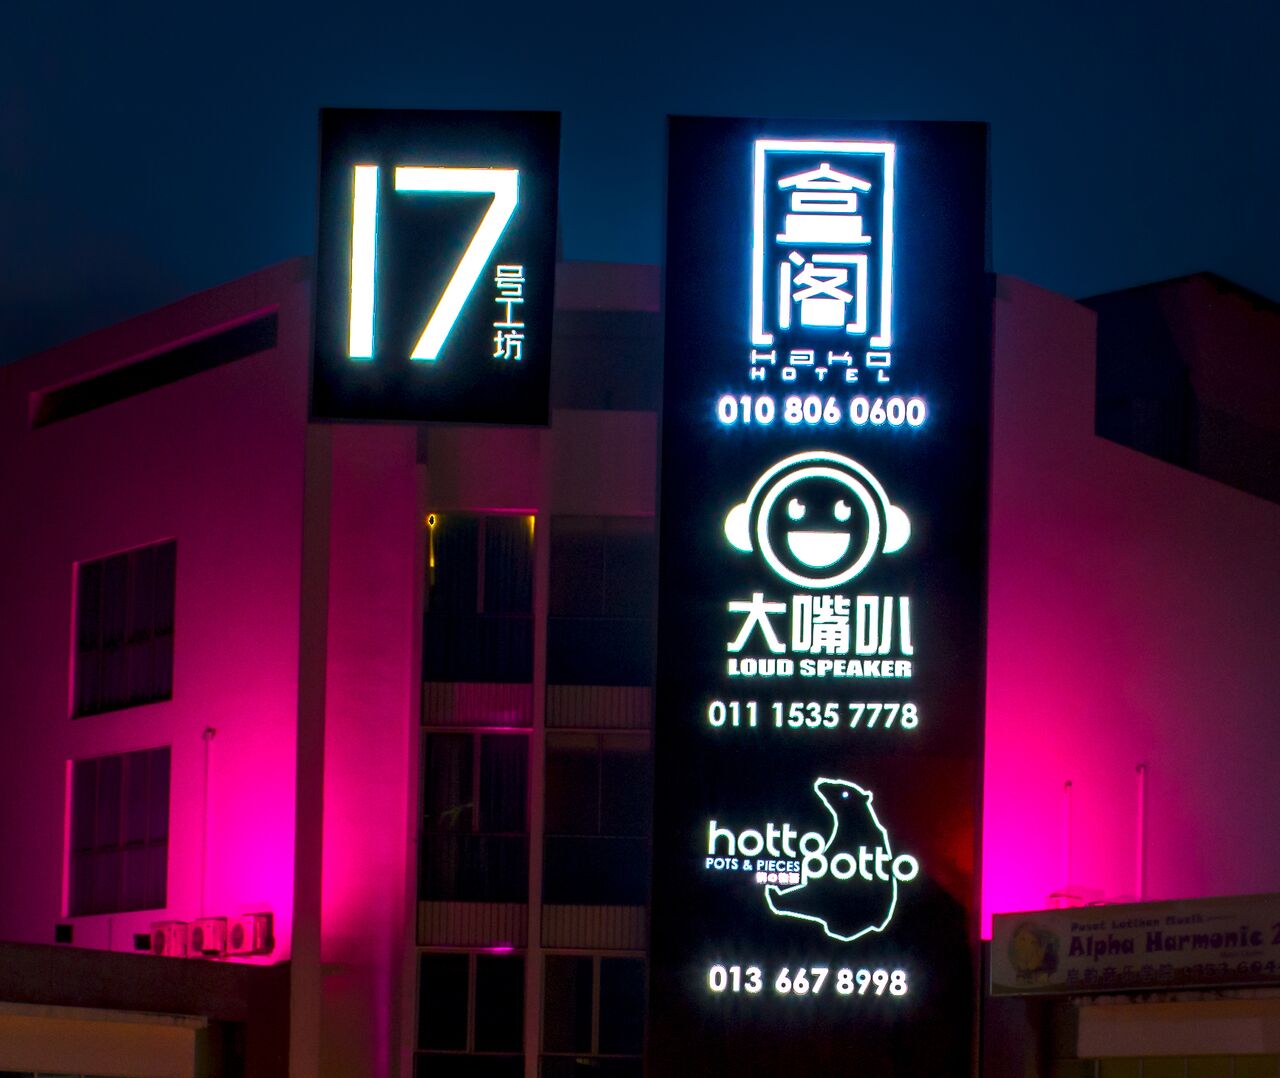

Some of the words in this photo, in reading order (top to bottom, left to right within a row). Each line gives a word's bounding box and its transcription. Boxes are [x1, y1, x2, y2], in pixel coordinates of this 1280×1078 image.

[348, 164, 520, 360] 17
[775, 162, 872, 334] 盒阁
[492, 264, 526, 361] 号工坊
[750, 366, 891, 382] HOTEL
[717, 394, 776, 426] 010
[783, 395, 842, 427] 806
[849, 396, 926, 427] 0600
[726, 592, 915, 657] 大嘴叭
[727, 658, 795, 677] LOUD
[799, 659, 913, 679] SPEAKER
[707, 701, 759, 728] 011
[771, 702, 840, 729] 1535
[848, 703, 920, 730] 7778
[705, 857, 739, 870] POTS
[742, 859, 753, 871] &
[756, 860, 801, 872] PIECES
[708, 820, 826, 858] hotto
[801, 845, 920, 885] potto
[1069, 934, 1135, 962] Alpha
[1146, 926, 1264, 954] Harmonic
[707, 965, 762, 994] 013
[775, 967, 829, 995] 667
[836, 968, 909, 996] 8998
